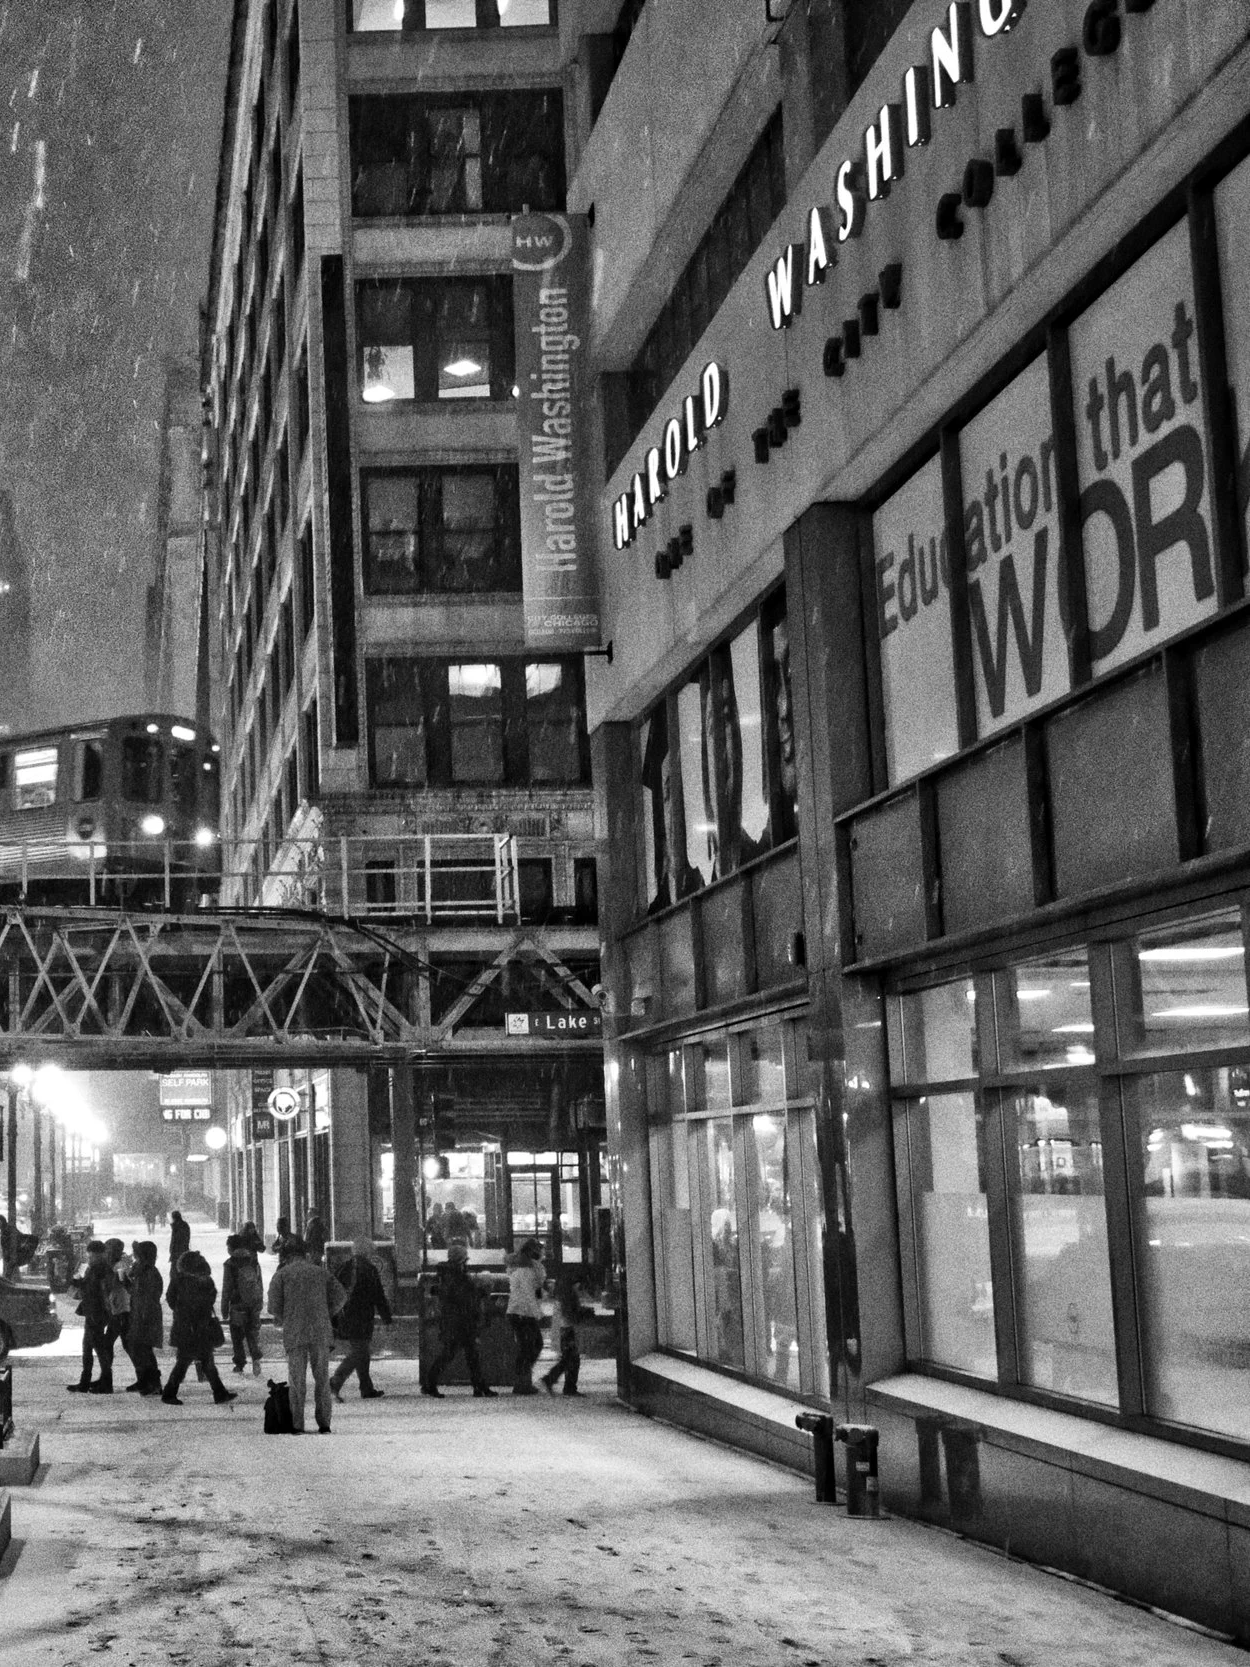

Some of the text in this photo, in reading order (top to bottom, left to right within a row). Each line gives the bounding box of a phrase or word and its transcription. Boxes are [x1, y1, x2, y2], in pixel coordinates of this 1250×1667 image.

[515, 236, 553, 248] HW
[530, 288, 581, 464] Washington
[655, 524, 694, 579] ONE
[707, 468, 736, 519] OF
[752, 388, 801, 464] THE
[823, 263, 903, 377] CITY
[1085, 302, 1199, 475] that
[532, 473, 577, 572] Harold
[614, 361, 722, 550] HAROLD
[162, 1078, 209, 1087] SELF PARK
[546, 1015, 588, 1030] Lake
